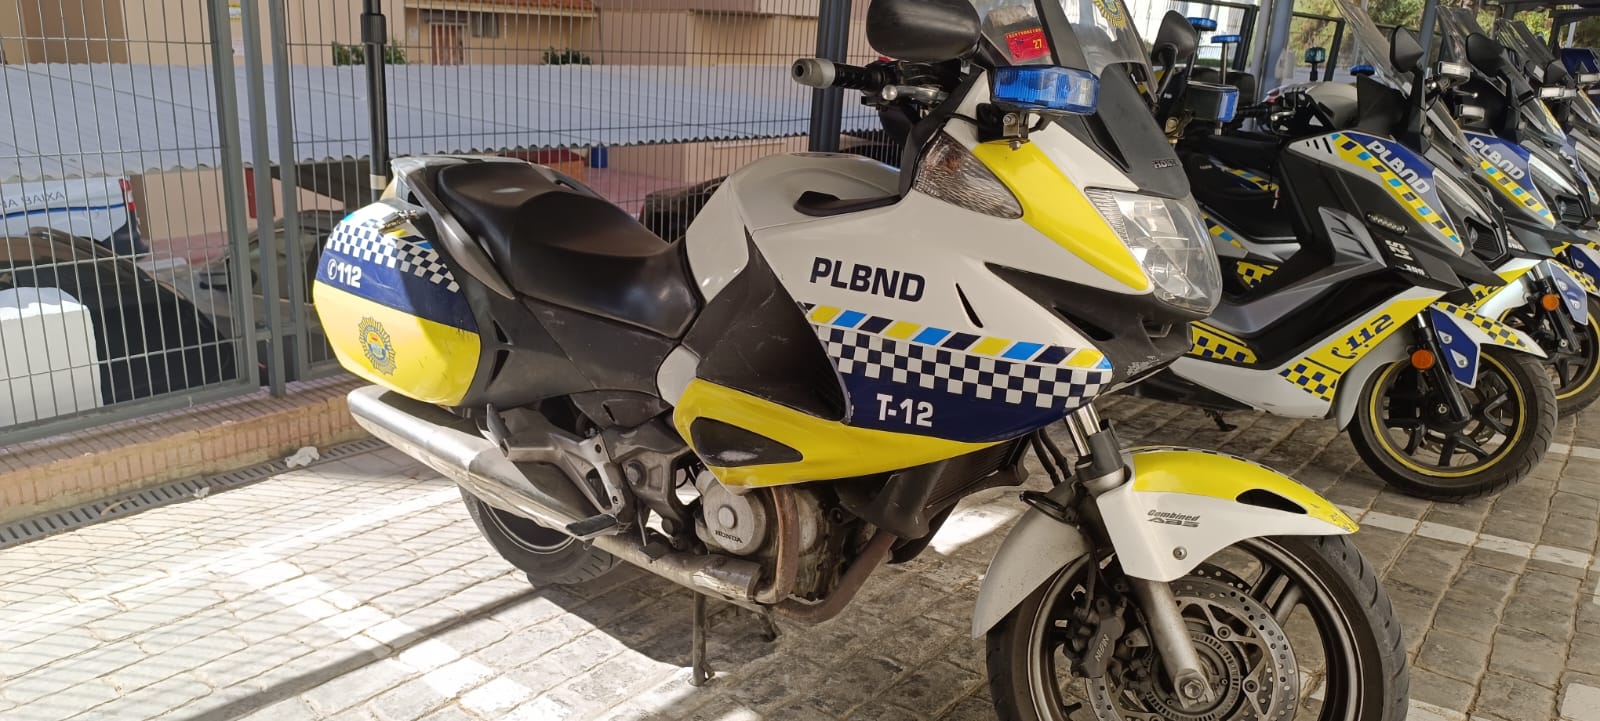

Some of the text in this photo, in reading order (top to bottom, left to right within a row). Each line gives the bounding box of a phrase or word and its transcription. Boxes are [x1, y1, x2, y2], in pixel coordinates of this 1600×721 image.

[1033, 38, 1043, 49] 27
[1366, 140, 1431, 194] PLBND
[1469, 137, 1525, 180] PLBND
[337, 262, 362, 288] 112
[809, 256, 926, 303] PLBND
[1346, 314, 1394, 351] 112
[876, 393, 935, 428] T-12
[1147, 509, 1201, 522] Combined
[714, 529, 744, 544] HONDA
